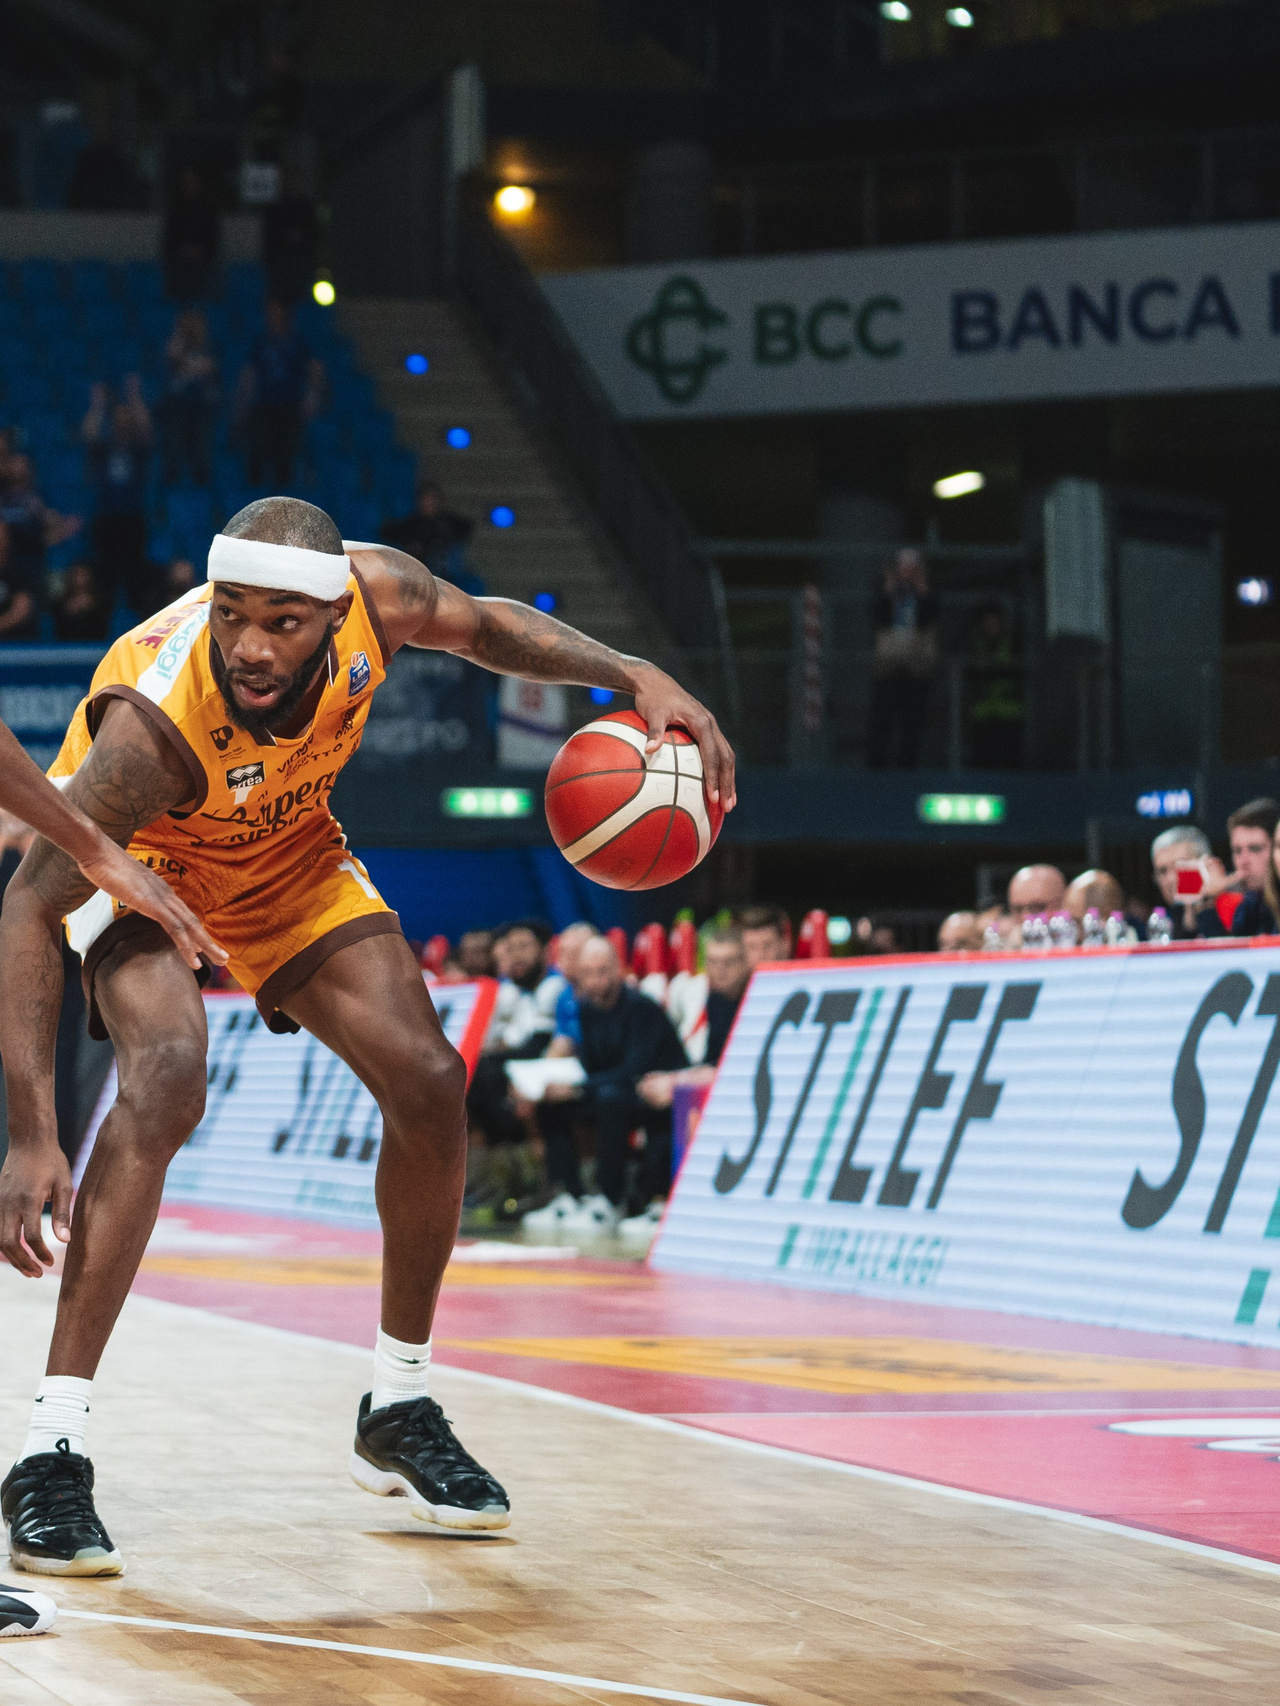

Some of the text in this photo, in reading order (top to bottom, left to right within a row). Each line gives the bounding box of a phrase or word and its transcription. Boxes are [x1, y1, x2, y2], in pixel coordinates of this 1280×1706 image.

[754, 295, 904, 367] BCC
[951, 275, 1243, 355] BANCA
[337, 858, 378, 899] 1
[713, 980, 1043, 1210] STILEF
[1121, 970, 1280, 1234] ST
